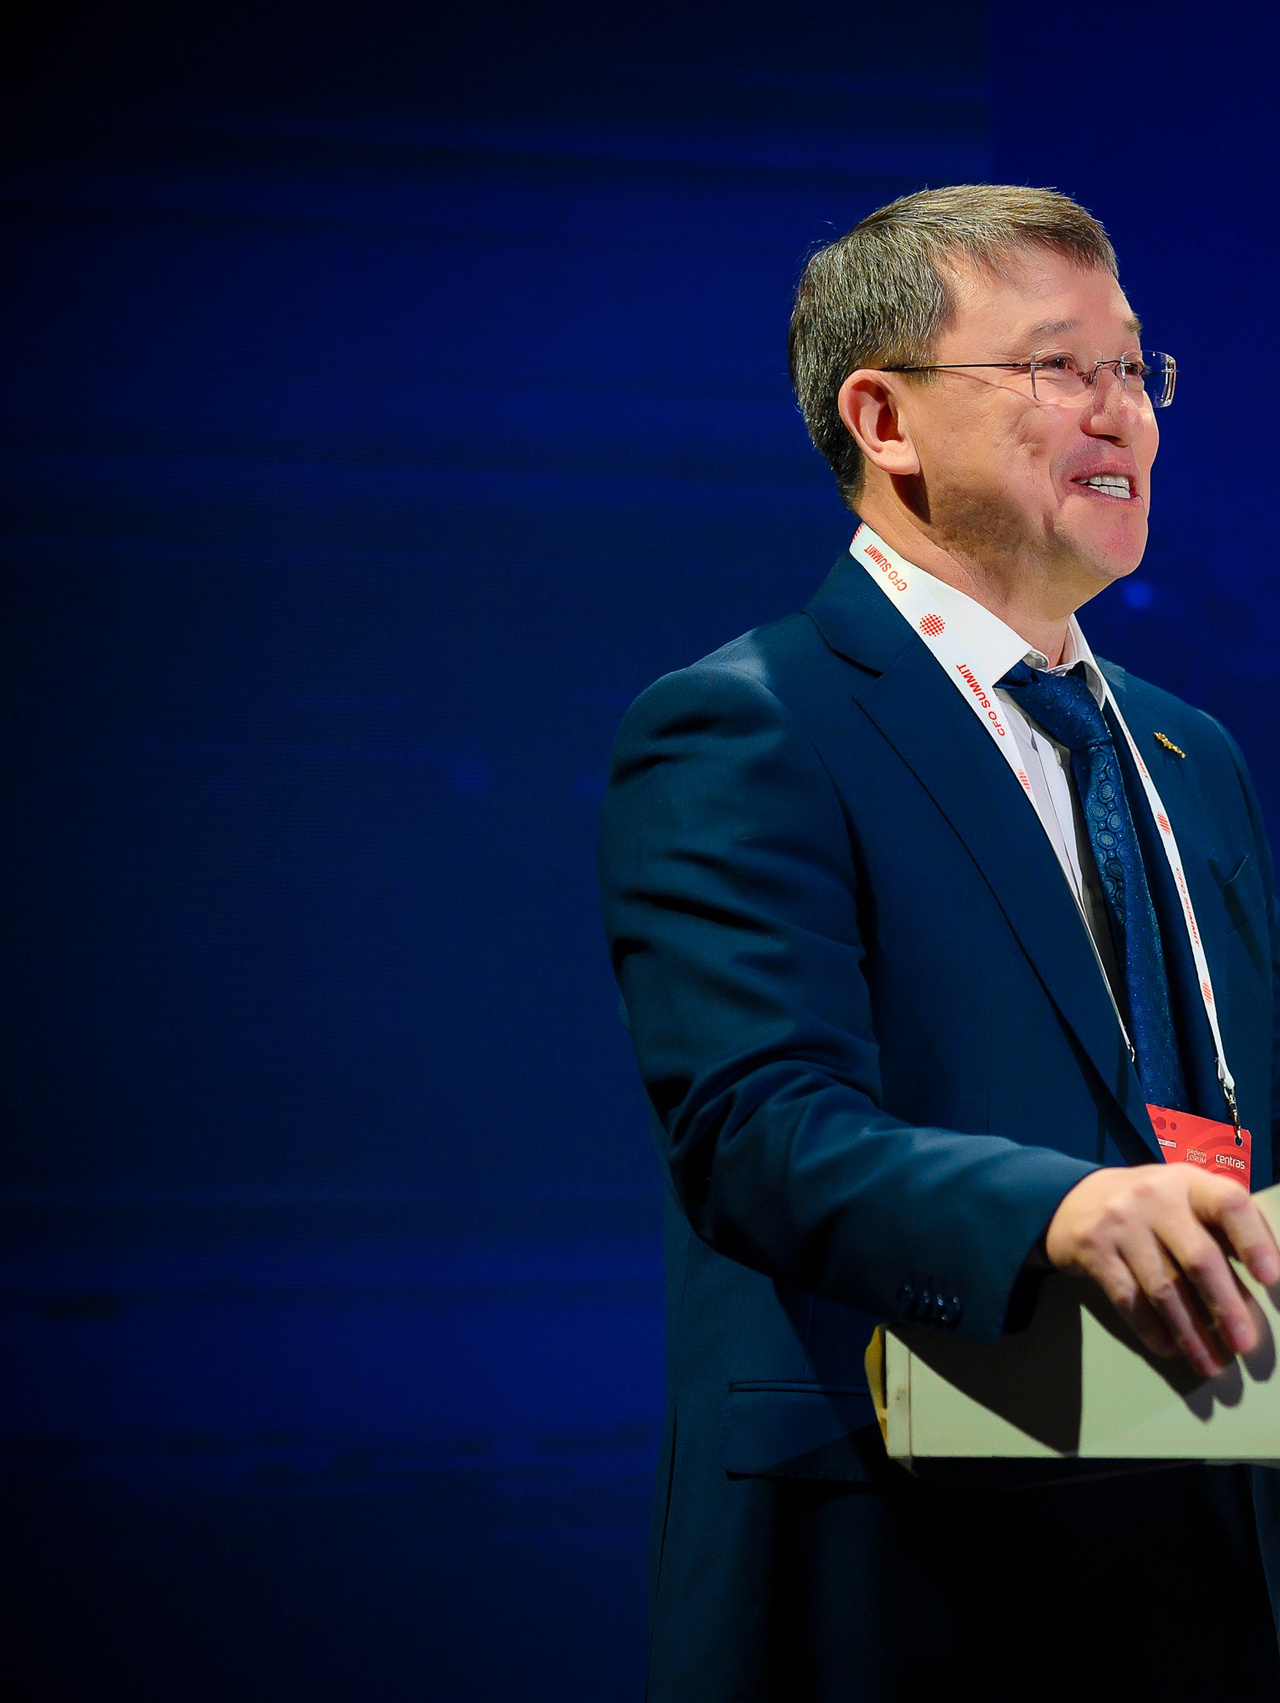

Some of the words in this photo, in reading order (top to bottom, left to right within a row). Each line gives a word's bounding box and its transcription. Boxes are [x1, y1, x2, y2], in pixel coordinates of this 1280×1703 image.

[863, 544, 892, 572] SUMMIT
[888, 570, 907, 592] CFO
[955, 663, 991, 709] SUMMIT
[988, 711, 1005, 737] CFO
[1215, 1154, 1246, 1170] centras
